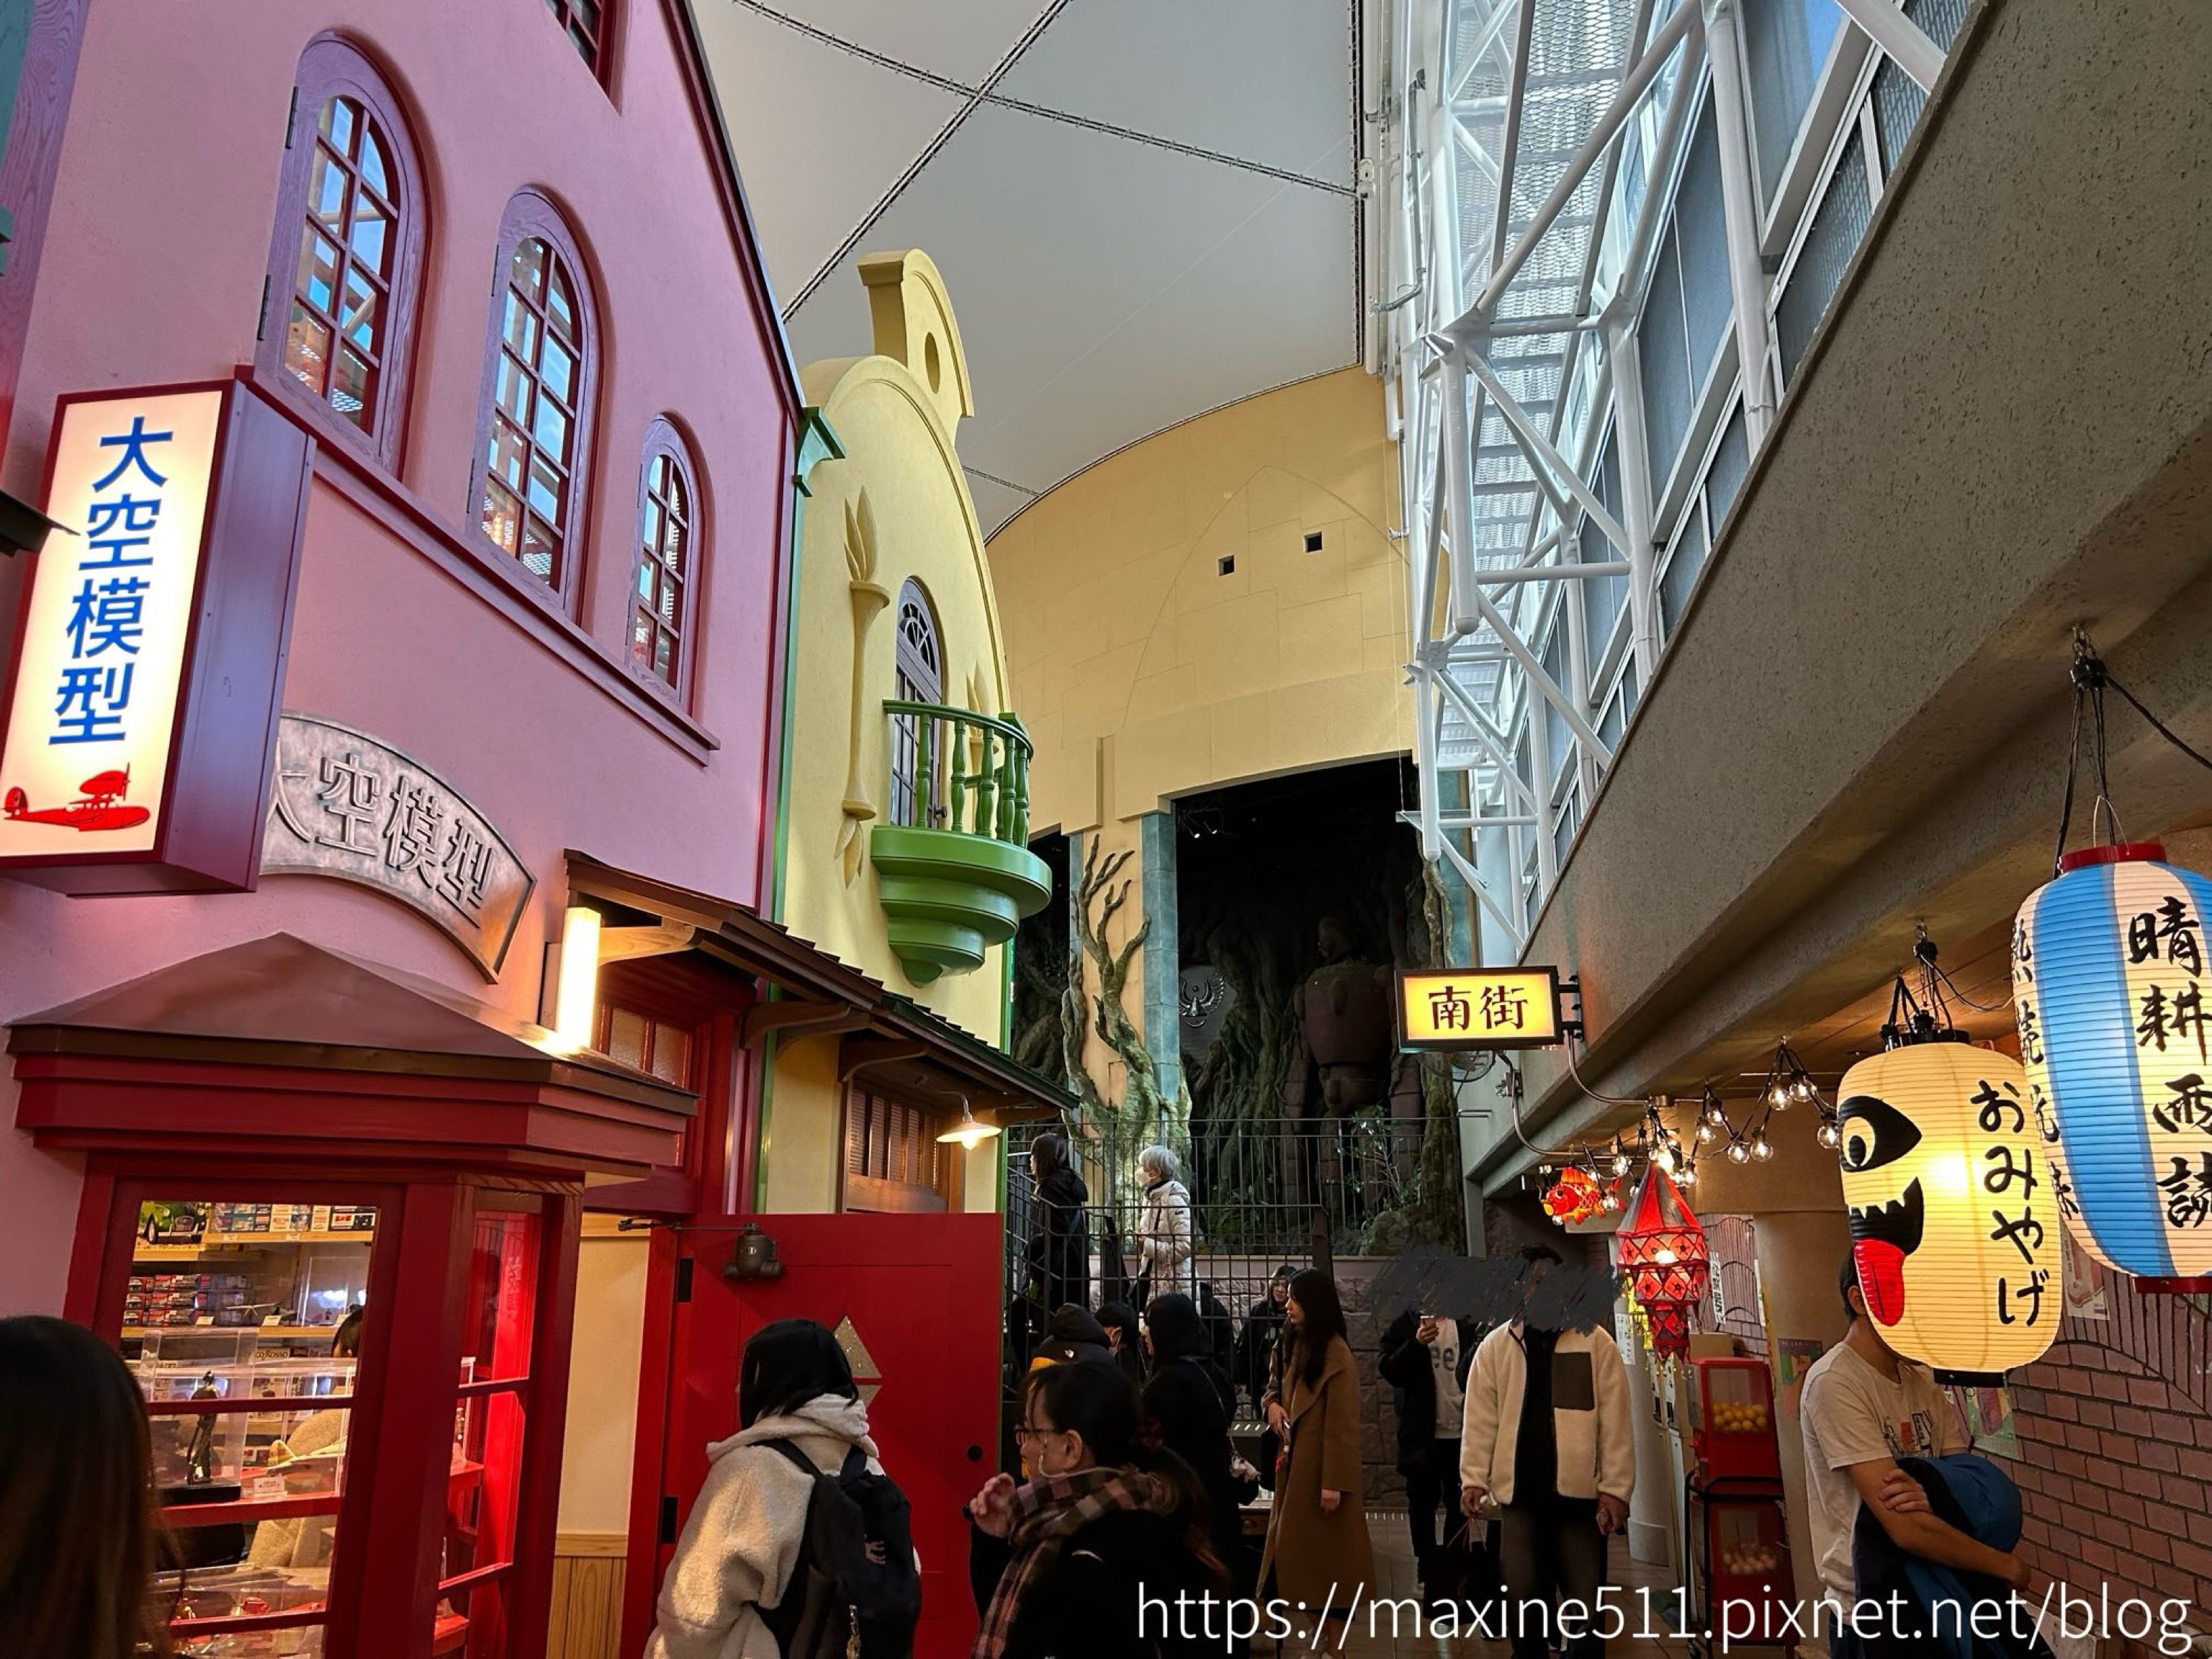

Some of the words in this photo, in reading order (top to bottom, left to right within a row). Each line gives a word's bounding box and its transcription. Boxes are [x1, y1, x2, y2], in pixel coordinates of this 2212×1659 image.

[48, 415, 174, 745] 大空模型
[1428, 985, 1529, 1030] 南街
[1969, 1079, 2051, 1327] おみやげ
